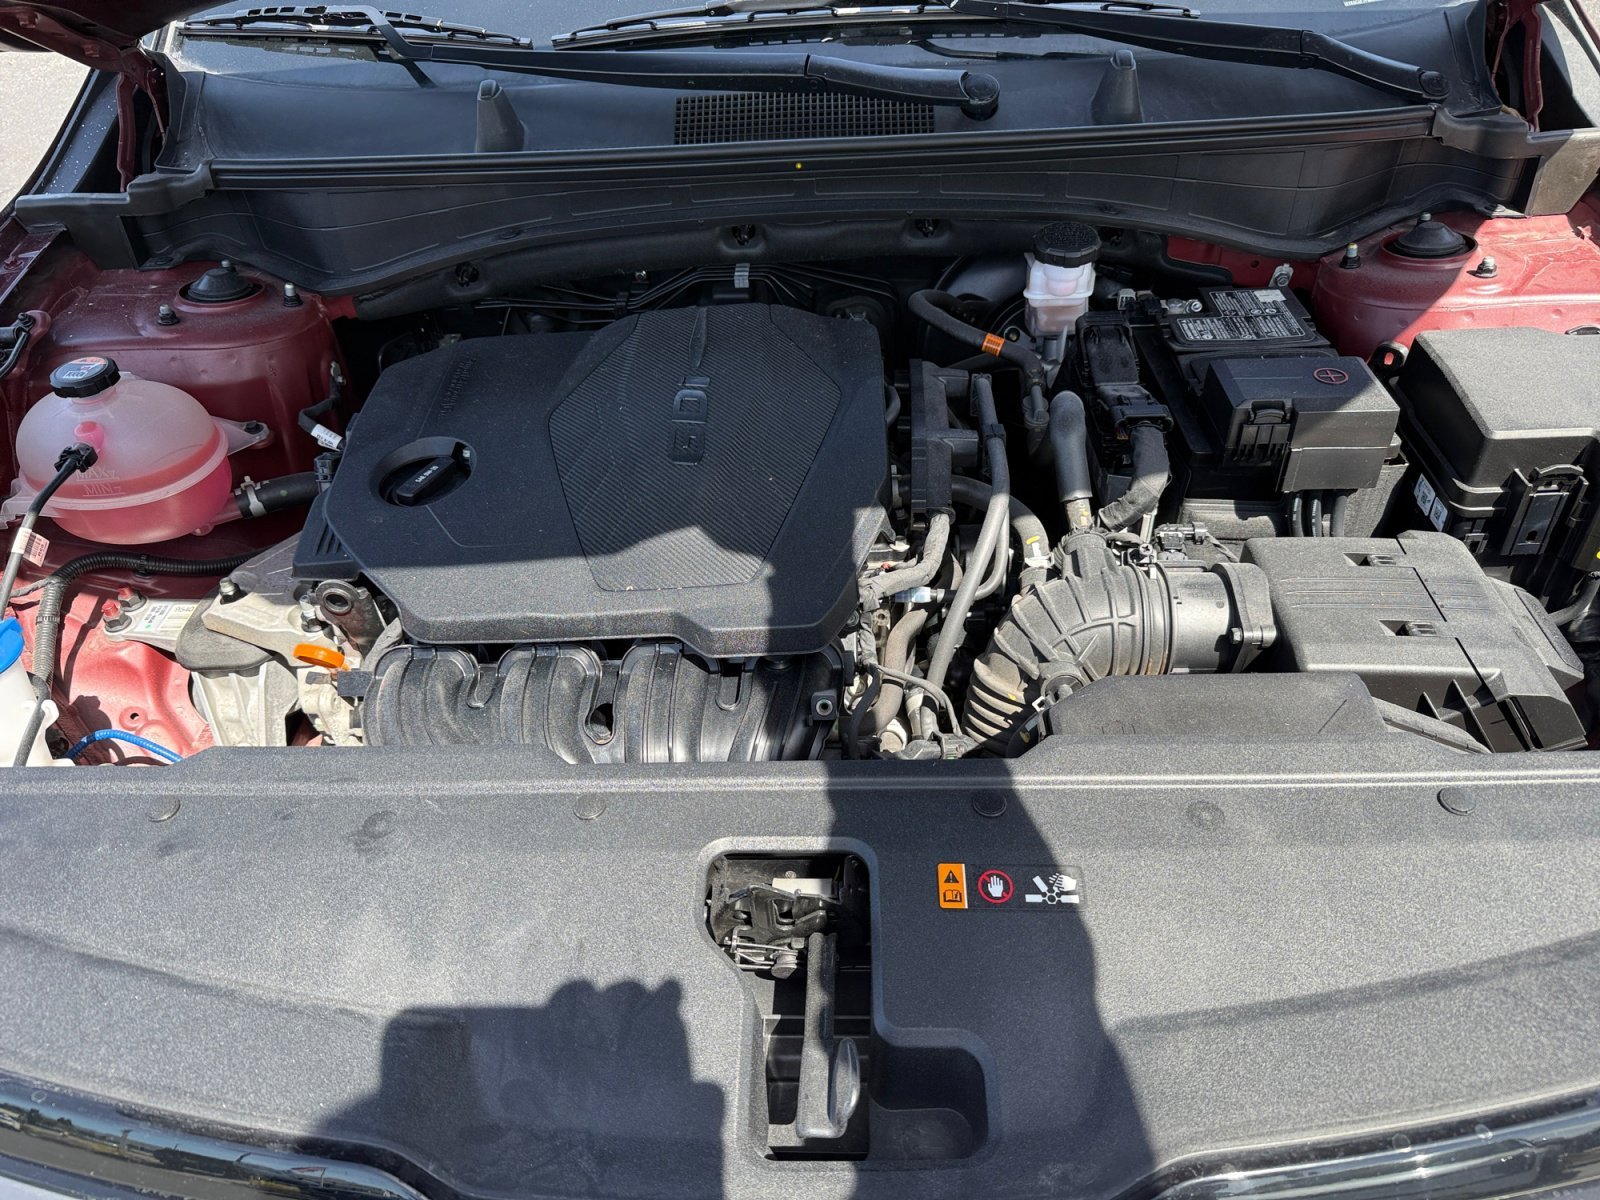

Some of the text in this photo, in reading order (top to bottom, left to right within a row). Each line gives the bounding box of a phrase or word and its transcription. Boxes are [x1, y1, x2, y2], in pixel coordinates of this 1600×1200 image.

[671, 376, 711, 466] GDI
[76, 466, 110, 480] MAX
[83, 484, 115, 496] MIN
